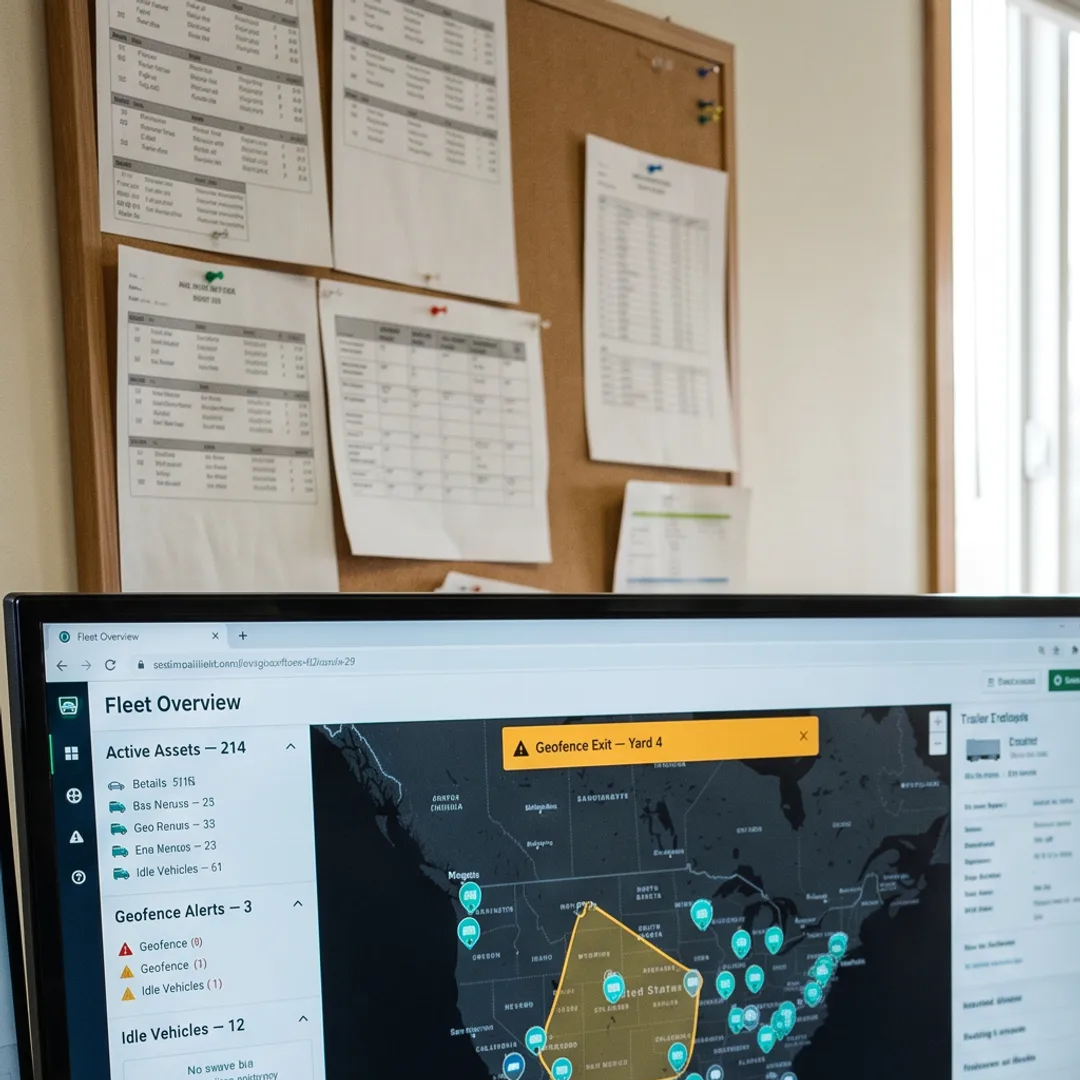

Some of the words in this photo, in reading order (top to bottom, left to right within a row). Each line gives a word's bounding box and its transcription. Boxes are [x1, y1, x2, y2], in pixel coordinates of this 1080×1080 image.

[77, 632, 98, 642] Fleet
[100, 632, 139, 642] Overview
[105, 696, 152, 714] Fleet
[157, 693, 241, 712] Overview
[106, 744, 150, 760] Active
[154, 742, 201, 757] Assets
[220, 741, 246, 755] 214
[535, 740, 589, 754] Geofence
[592, 738, 612, 751] Exit
[628, 736, 652, 750] Yard
[655, 736, 663, 748] 4
[132, 778, 167, 789] Betails
[133, 822, 154, 834] Geo
[203, 819, 216, 829] 33
[204, 840, 217, 851] 23
[136, 866, 155, 878] Idle
[157, 864, 199, 877] Vehicles
[211, 862, 222, 873] 61
[115, 907, 181, 923] Geofence
[185, 903, 225, 918] Alerts
[244, 900, 252, 913] 3
[139, 938, 188, 952] Geofence
[140, 960, 189, 975] Geofence
[193, 958, 207, 970] (1)
[141, 984, 160, 996] Idle
[163, 980, 204, 994] Vehicles
[121, 1029, 147, 1044] Idle
[150, 1023, 209, 1041] Vehicles
[228, 1018, 245, 1032] 12
[187, 1065, 203, 1076] No
